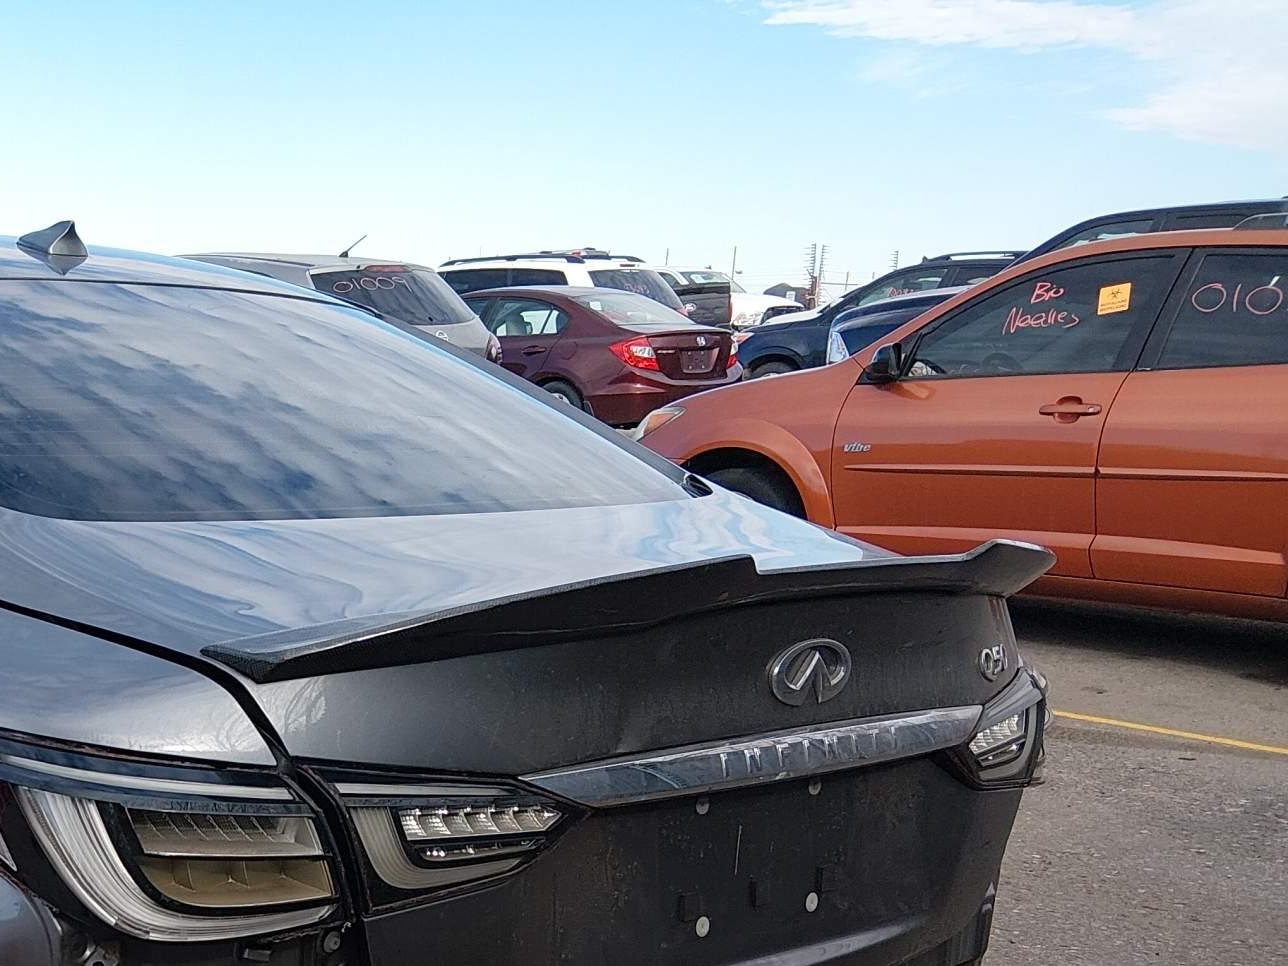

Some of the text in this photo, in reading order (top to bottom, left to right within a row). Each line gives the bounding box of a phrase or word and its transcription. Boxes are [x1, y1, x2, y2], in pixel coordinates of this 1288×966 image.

[332, 276, 412, 293] 01009
[1030, 281, 1065, 305] Bio
[719, 724, 899, 780] INFINITI
